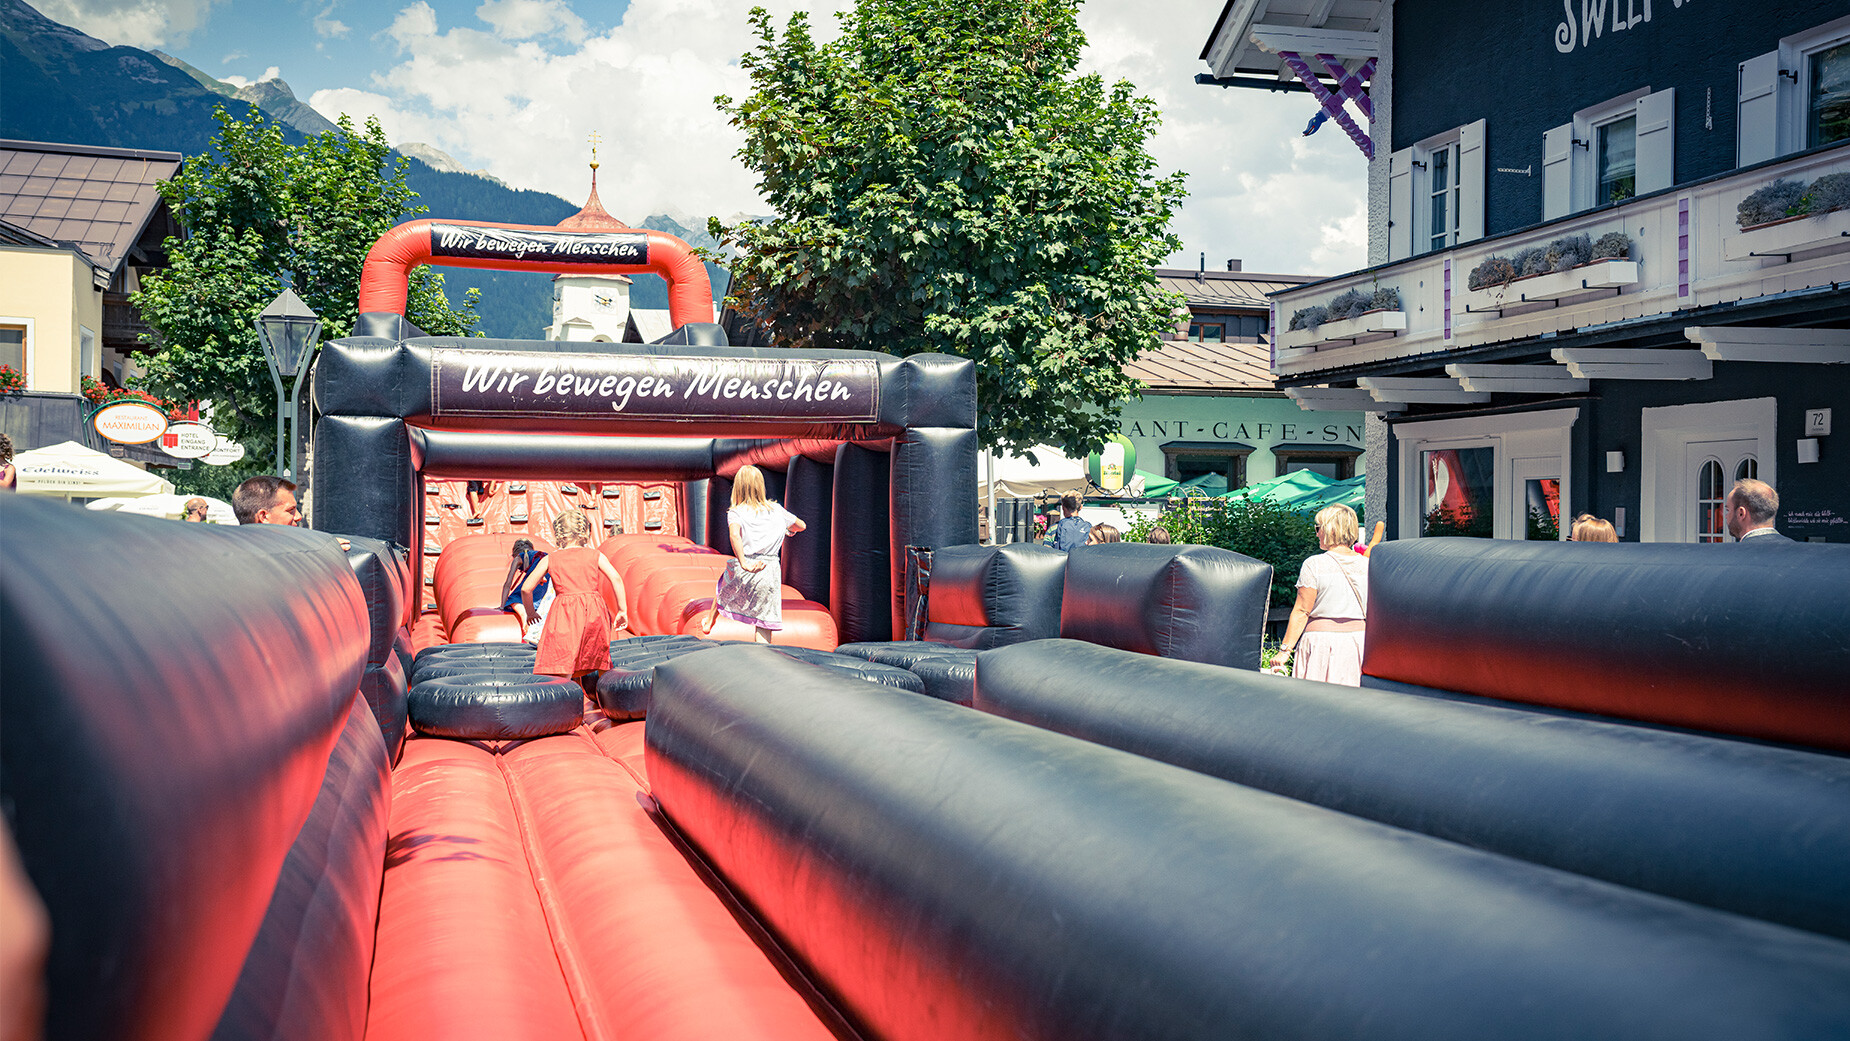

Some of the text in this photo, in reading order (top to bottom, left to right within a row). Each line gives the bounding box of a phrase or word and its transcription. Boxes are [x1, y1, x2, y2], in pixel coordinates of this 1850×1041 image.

[440, 231, 639, 259] Wir bewegen Menschen
[461, 364, 852, 412] Wir bewegen Menschen
[1813, 412, 1824, 425] 72
[102, 422, 160, 431] MAXIMILIAN
[22, 466, 99, 475] Edelweiss
